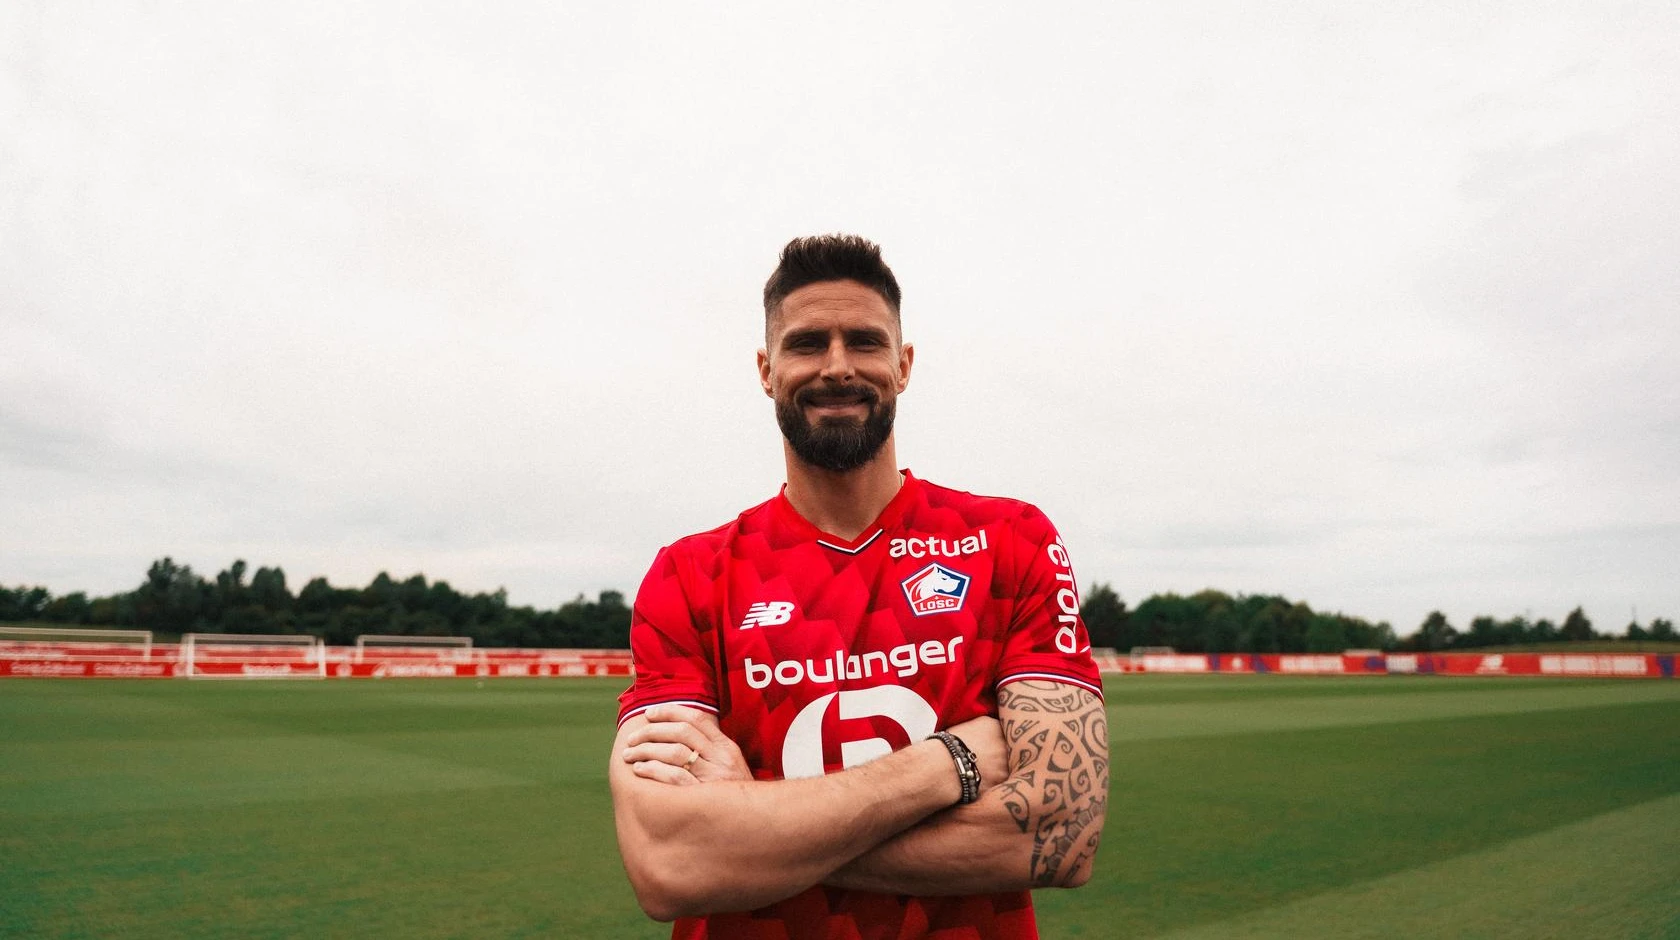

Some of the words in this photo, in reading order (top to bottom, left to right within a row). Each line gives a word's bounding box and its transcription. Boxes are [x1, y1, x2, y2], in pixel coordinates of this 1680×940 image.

[889, 529, 988, 558] actual
[739, 601, 795, 630] NB
[919, 598, 956, 611] LOSC
[744, 635, 964, 689] boulanger
